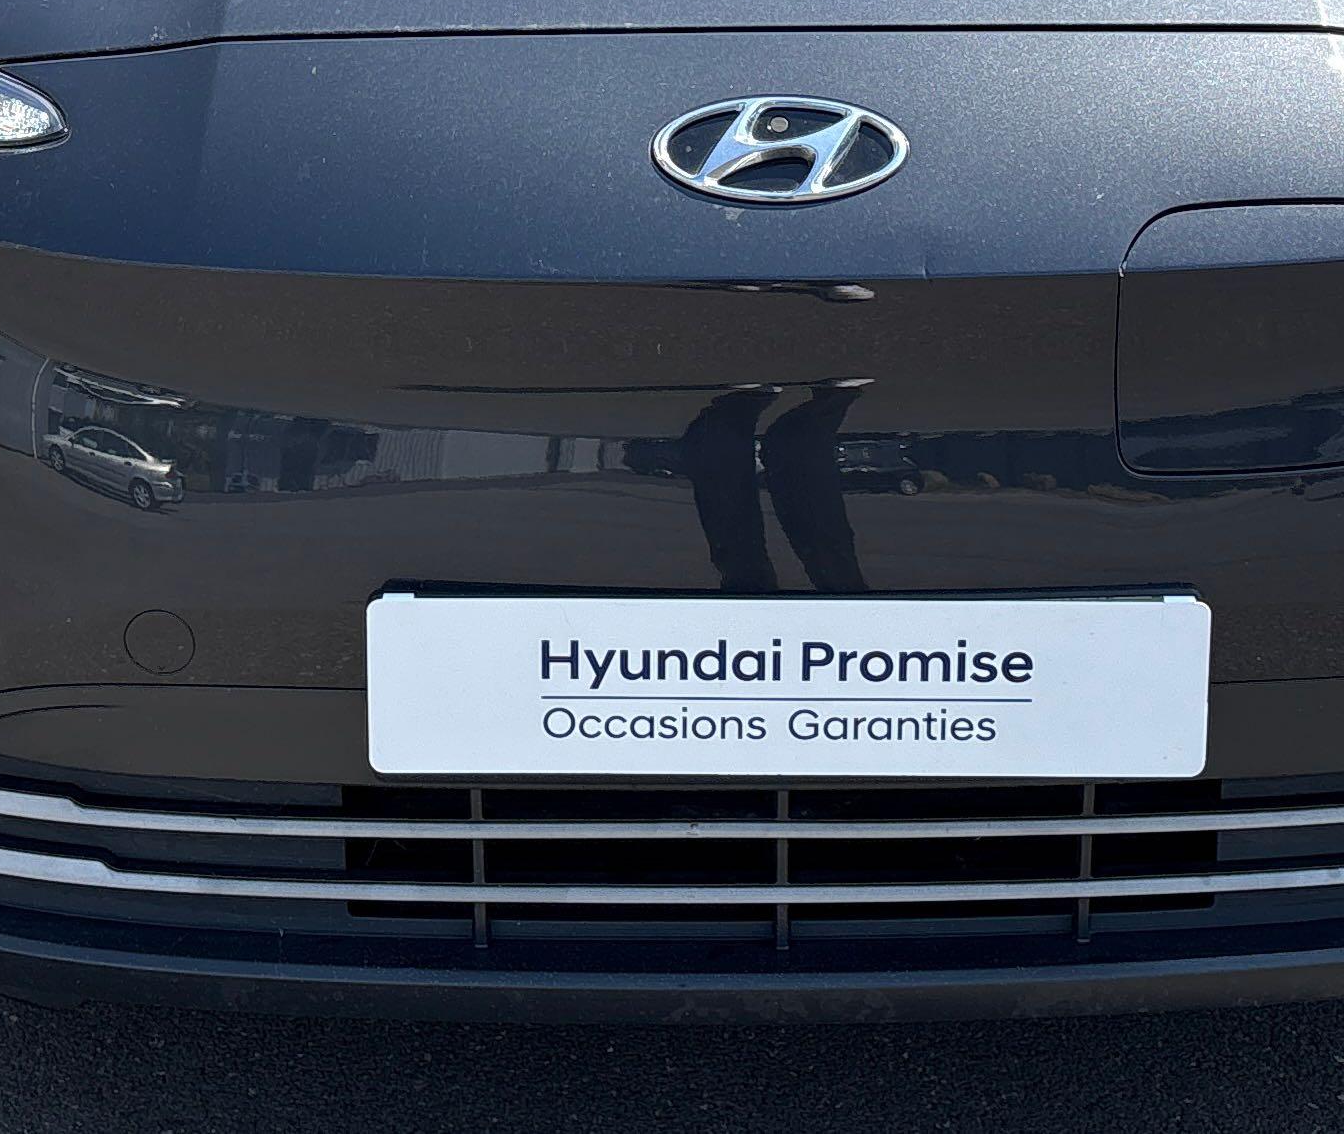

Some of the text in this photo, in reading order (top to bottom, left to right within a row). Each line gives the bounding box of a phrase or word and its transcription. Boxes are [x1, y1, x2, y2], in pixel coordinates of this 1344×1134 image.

[541, 638, 1034, 690] Hyundai Promise
[542, 706, 997, 742] Occasions Garanties
